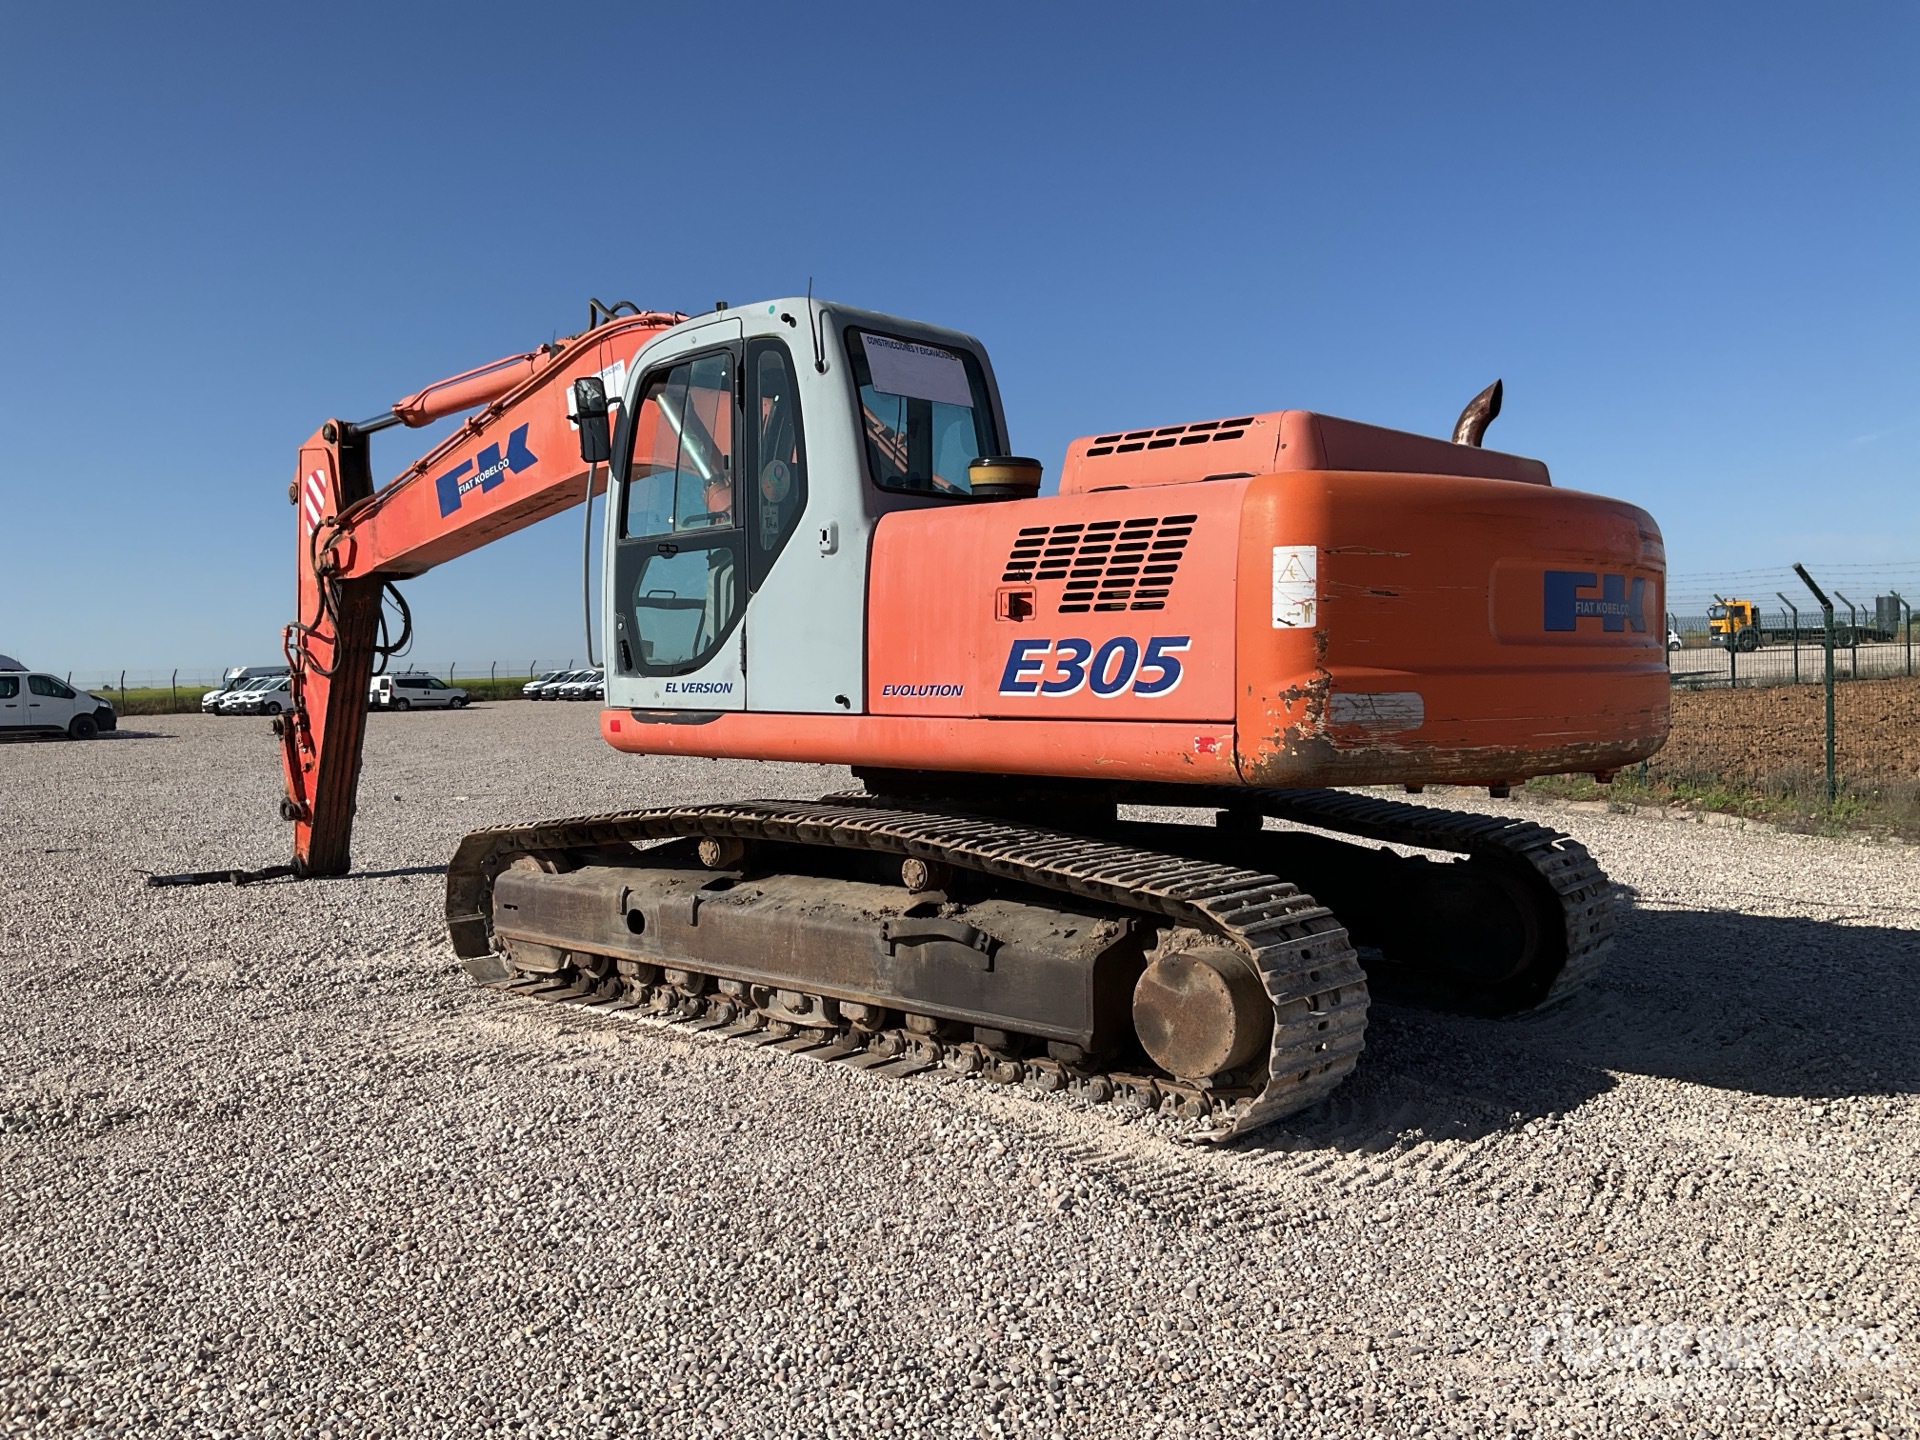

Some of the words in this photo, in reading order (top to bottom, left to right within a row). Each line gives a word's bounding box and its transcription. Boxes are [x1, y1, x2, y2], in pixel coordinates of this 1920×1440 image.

[866, 335, 915, 353] CONSTRUCCIONES
[458, 479, 474, 495] FIAT
[475, 458, 510, 485] KOBELCO
[1575, 601, 1595, 614] FIAT
[1596, 602, 1630, 616] KOBELCO
[998, 636, 1193, 699] E305
[665, 682, 678, 693] EL
[681, 682, 734, 694] VERSION
[882, 684, 964, 698] EVOLUTION
